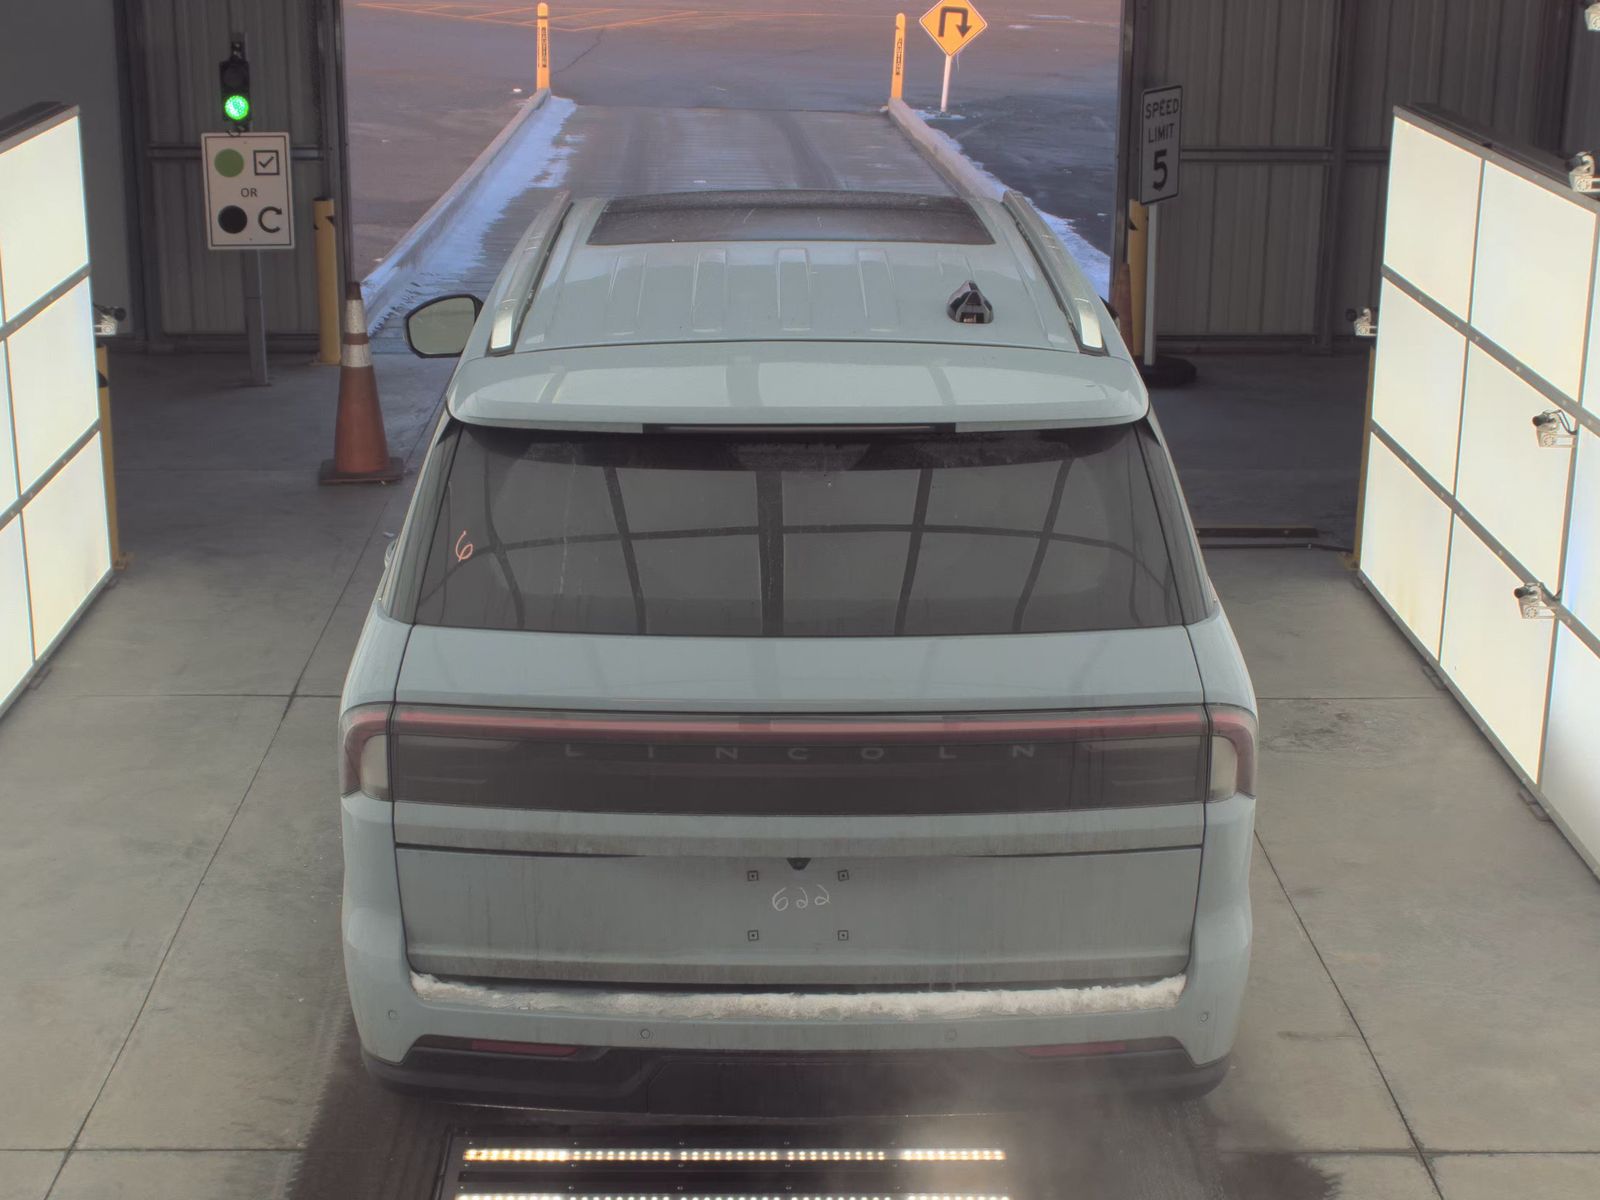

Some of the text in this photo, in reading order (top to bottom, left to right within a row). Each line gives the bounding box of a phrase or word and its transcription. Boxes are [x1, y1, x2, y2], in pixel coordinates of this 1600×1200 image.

[1145, 98, 1179, 119] SPEED
[1148, 123, 1174, 143] LIMIT
[1152, 149, 1168, 192] 5
[240, 187, 258, 198] OR
[455, 530, 474, 562] 6
[565, 743, 1036, 760] LINCOLN
[772, 884, 831, 911] 622
